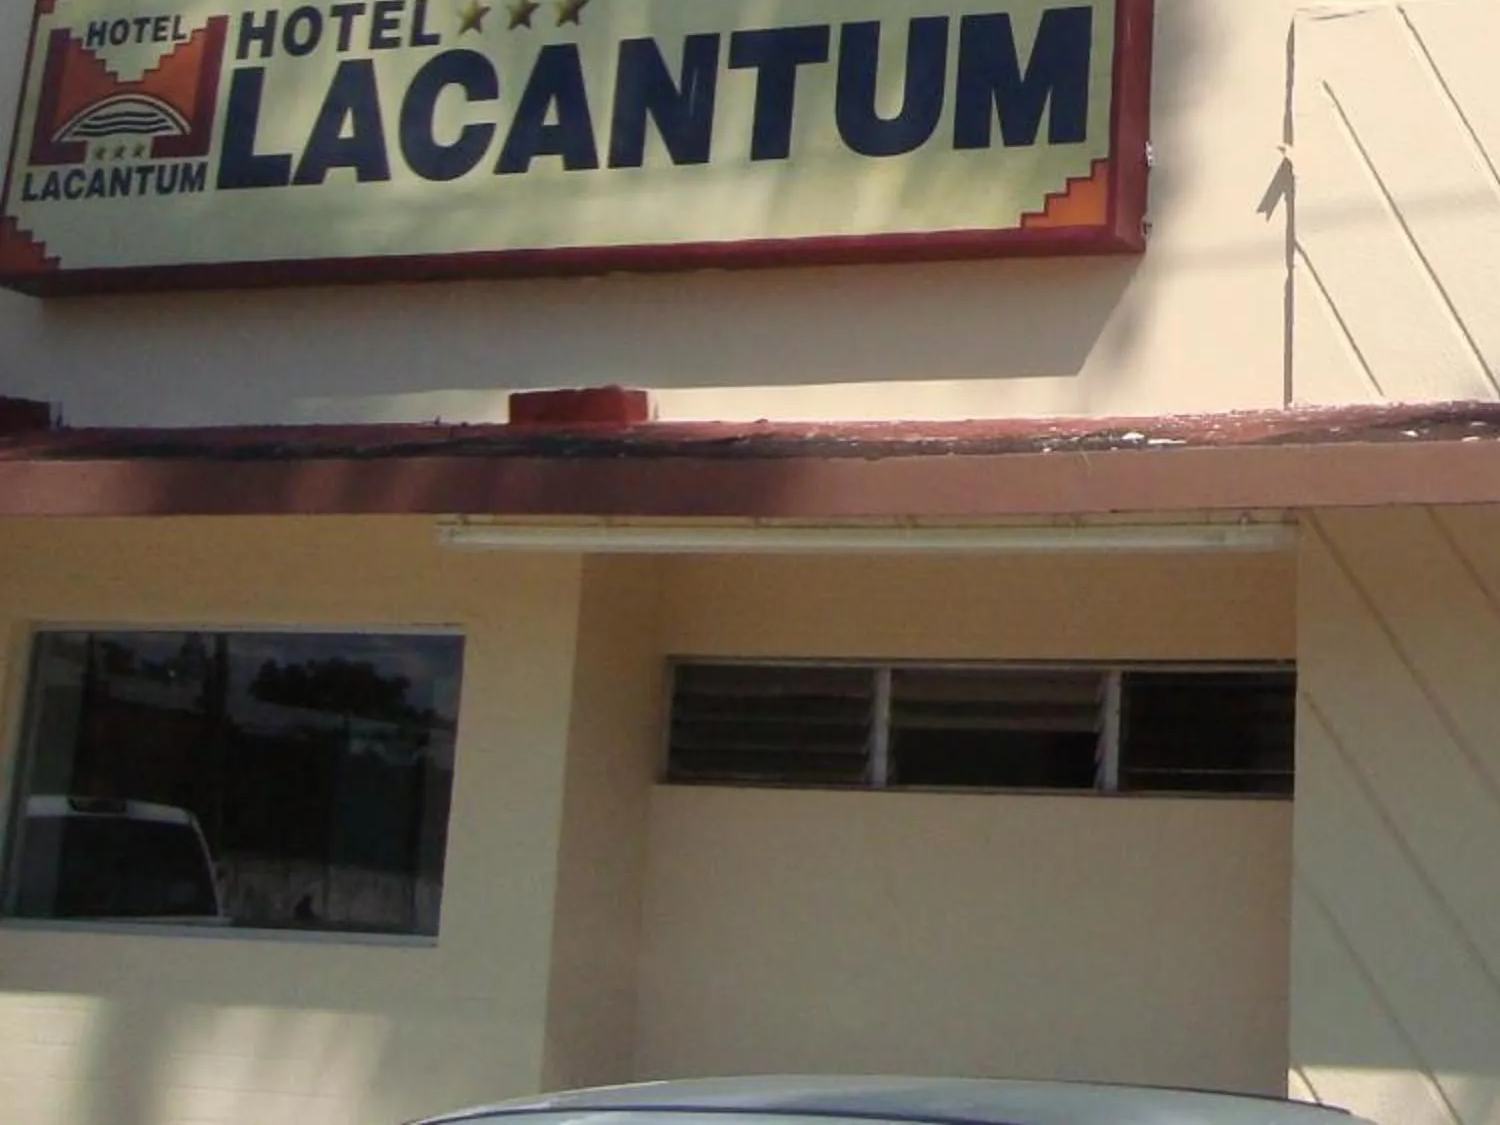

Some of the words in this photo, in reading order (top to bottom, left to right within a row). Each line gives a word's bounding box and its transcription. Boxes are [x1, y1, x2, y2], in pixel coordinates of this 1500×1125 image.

[86, 15, 187, 47] HOTEL
[216, 6, 1093, 190] LACANTUM
[22, 162, 208, 202] LACANTUM
